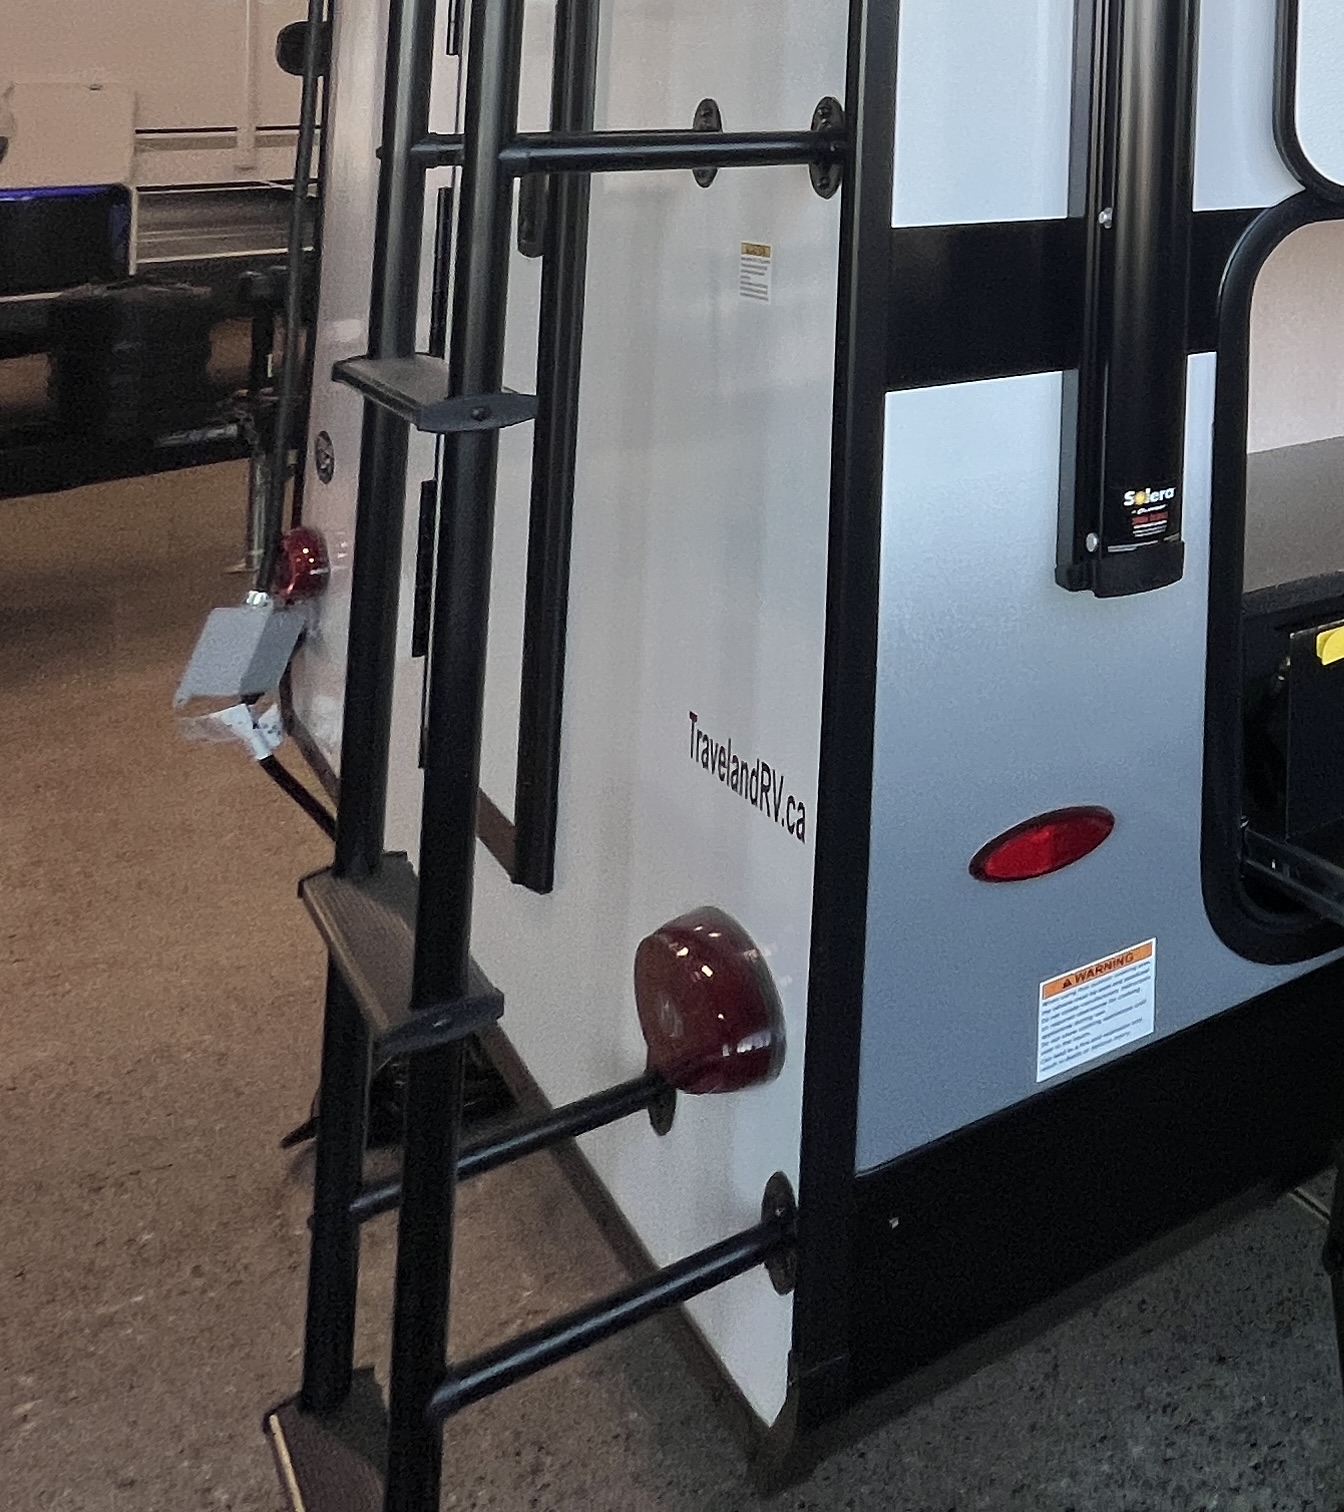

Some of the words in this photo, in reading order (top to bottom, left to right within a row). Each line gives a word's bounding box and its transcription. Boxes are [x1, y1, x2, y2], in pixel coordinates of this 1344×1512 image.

[1123, 487, 1177, 507] Solera
[689, 710, 806, 845] TravelandRV.ca
[1074, 952, 1135, 984] WARNING
